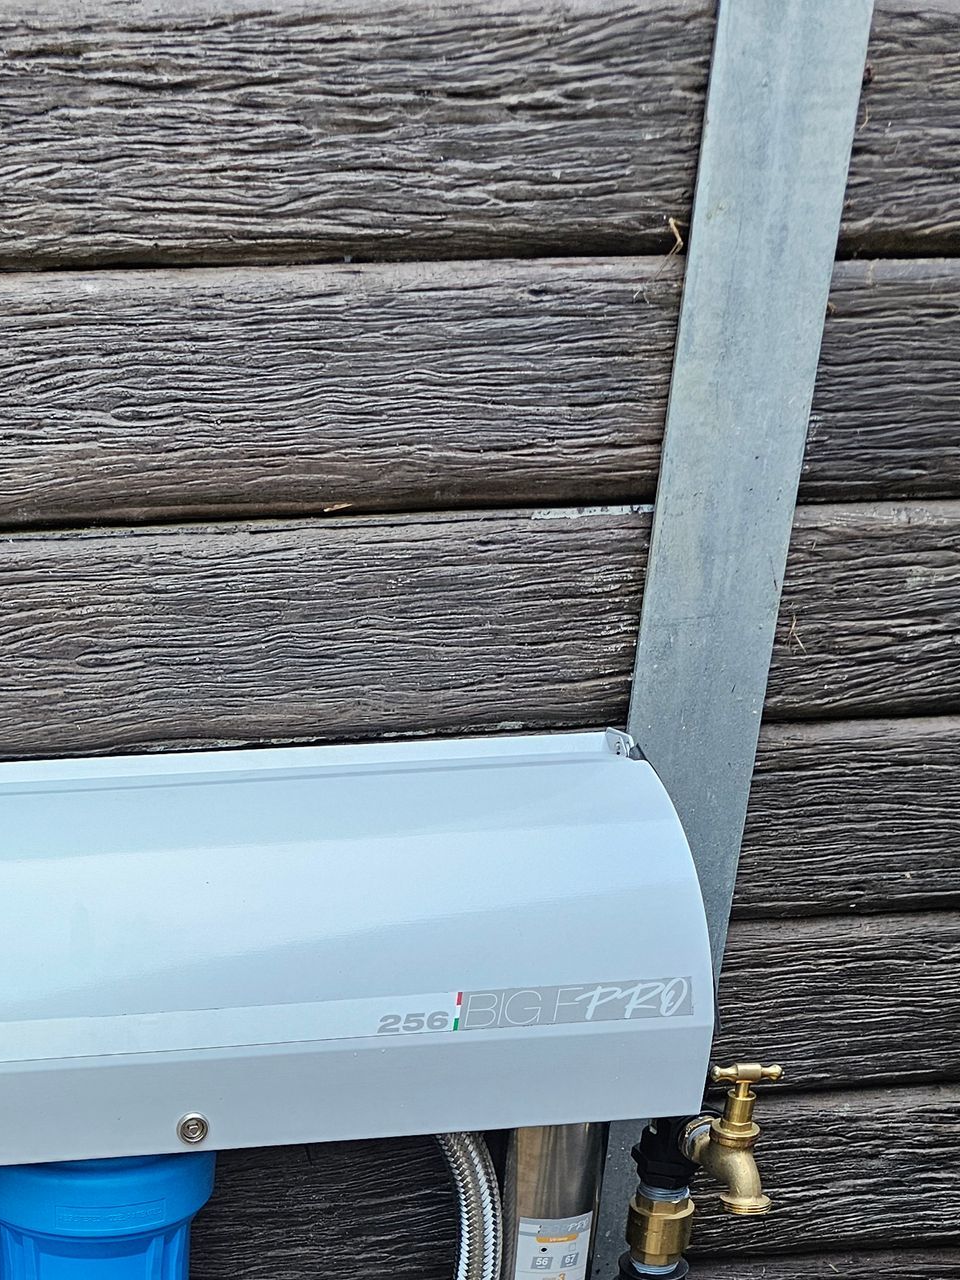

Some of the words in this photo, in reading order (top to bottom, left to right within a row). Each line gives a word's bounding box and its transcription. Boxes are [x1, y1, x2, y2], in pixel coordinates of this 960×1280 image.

[377, 1011, 449, 1034] 256
[463, 989, 542, 1028] BIG
[574, 977, 688, 1020] PRO
[535, 1257, 549, 1266] 56
[564, 1254, 577, 1264] 67
